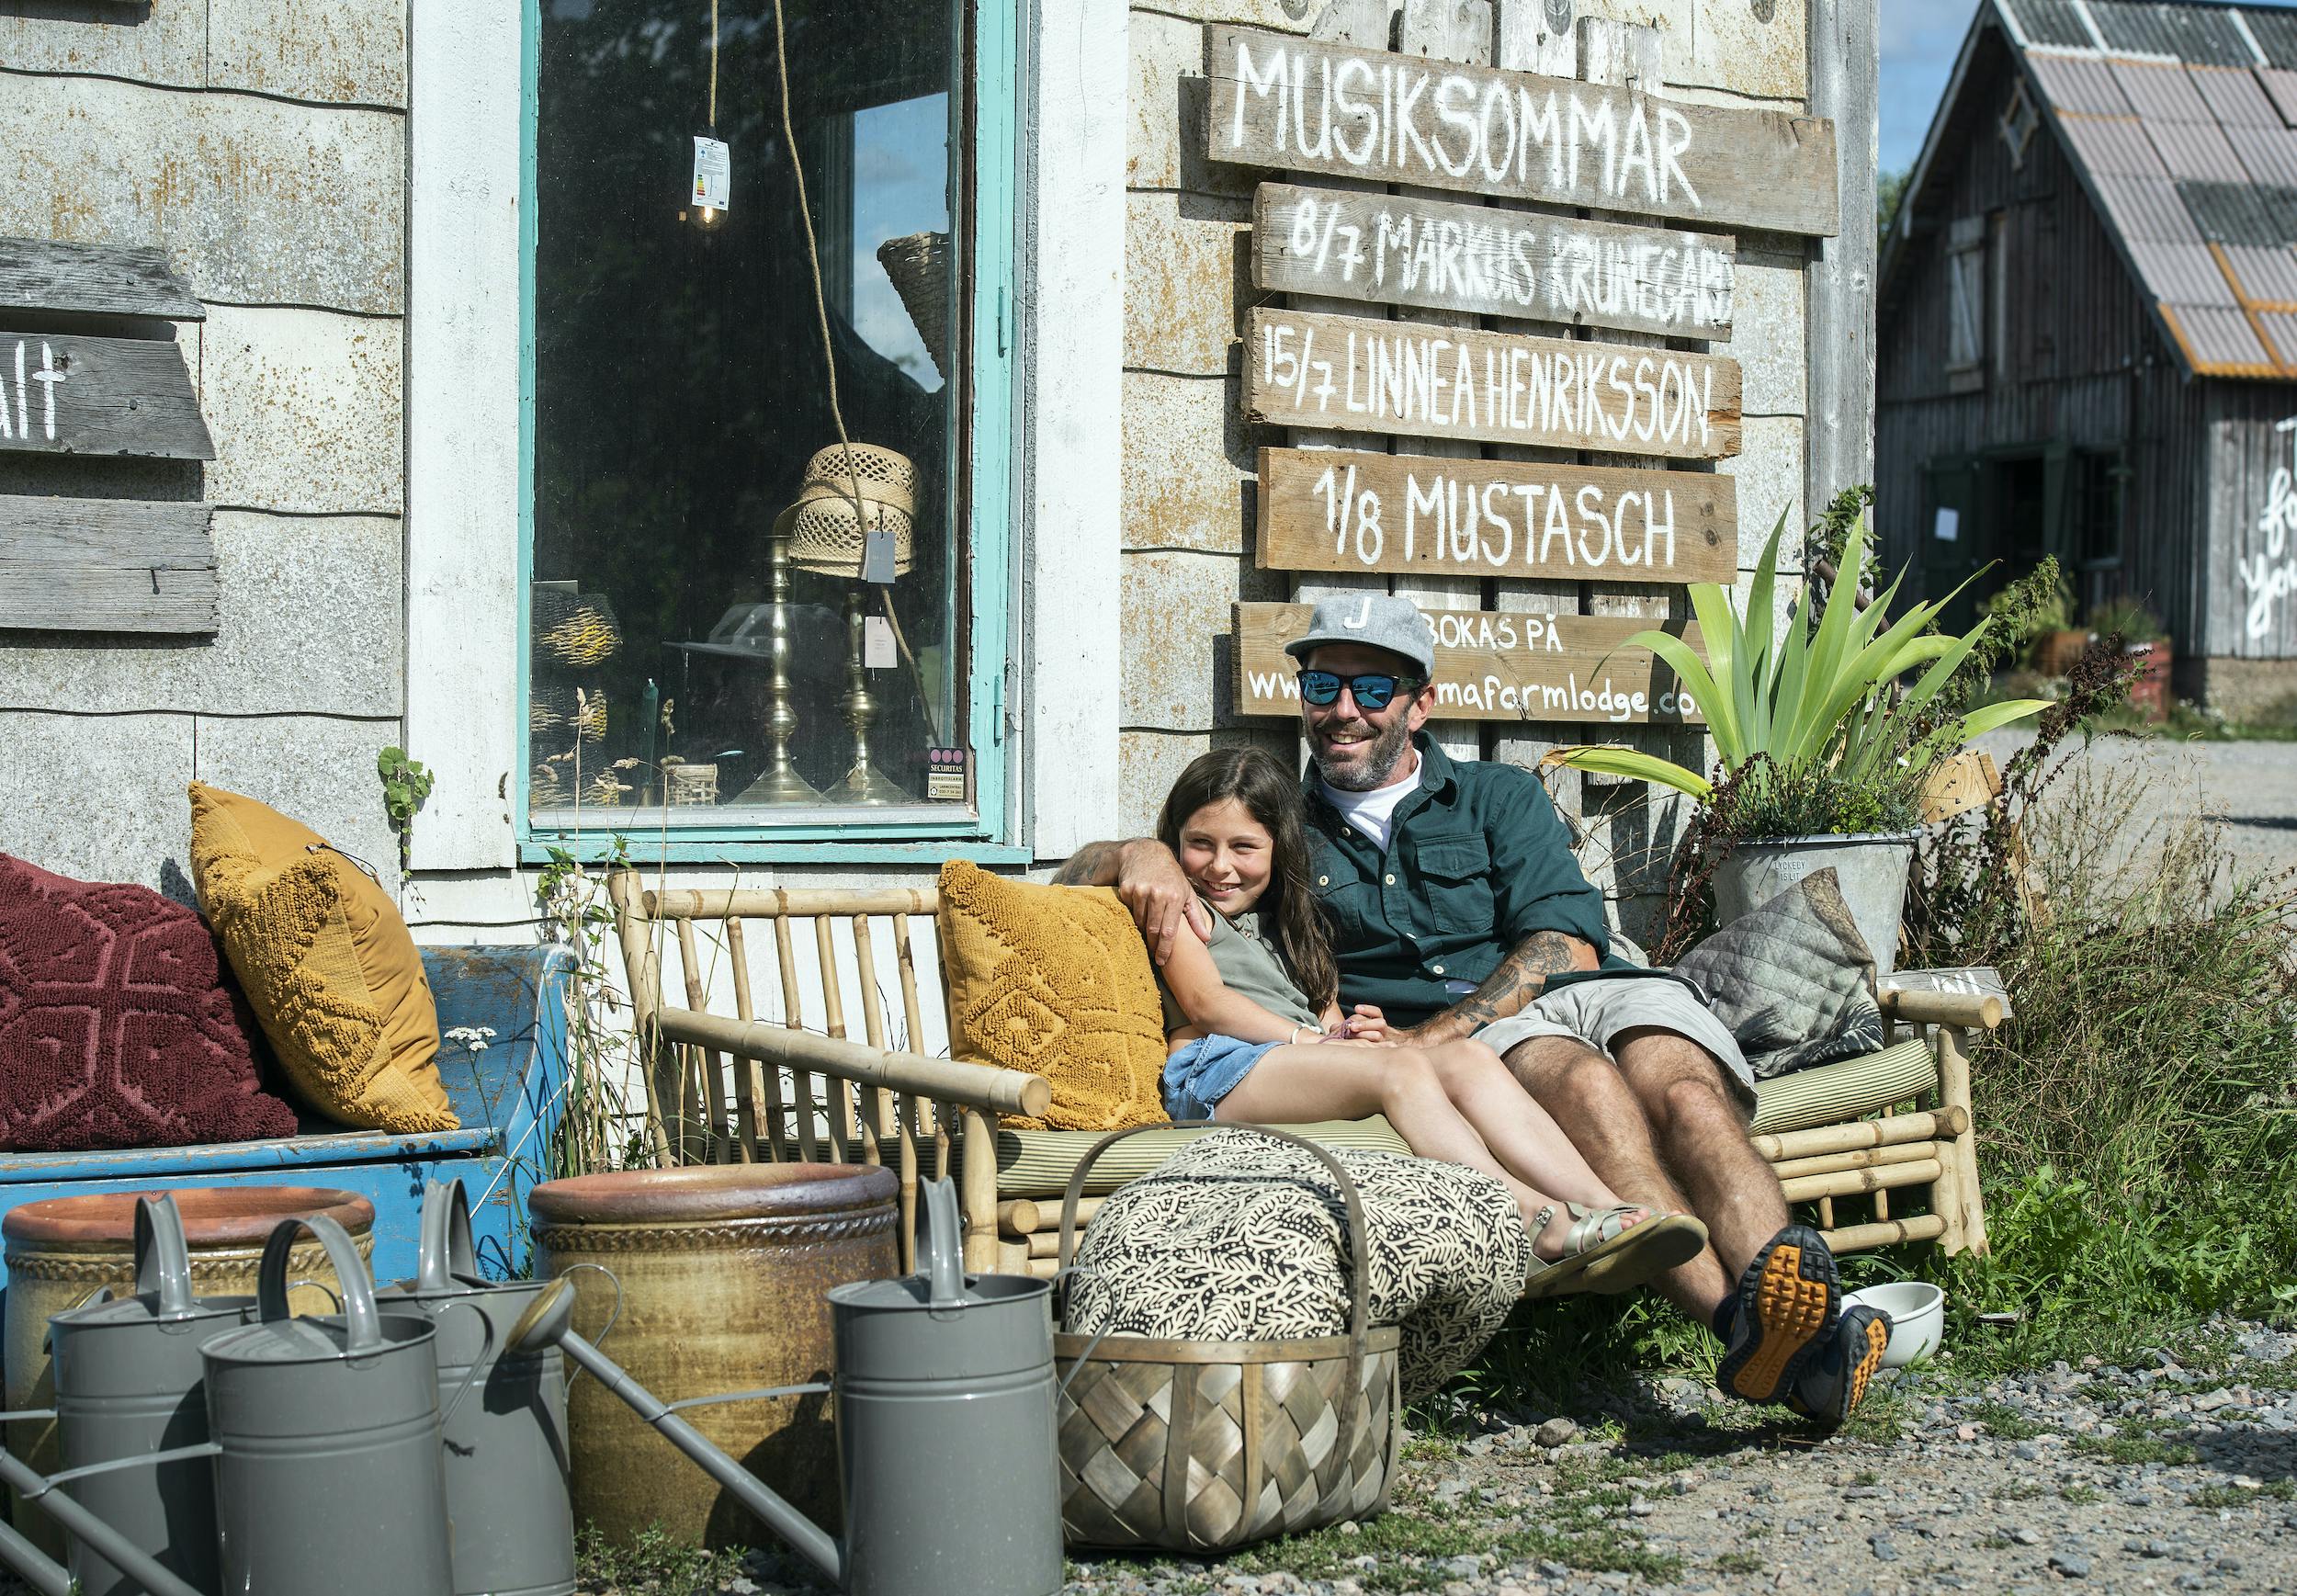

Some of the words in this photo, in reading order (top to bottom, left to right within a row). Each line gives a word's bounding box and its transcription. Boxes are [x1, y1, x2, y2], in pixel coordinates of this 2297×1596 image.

[1233, 42, 1703, 209] MUSIKSOMMAR
[1292, 198, 1365, 283] 8/7
[1376, 205, 1536, 307] MARKUS
[0, 340, 66, 440] lt
[1263, 324, 1337, 413] 15/7
[1346, 334, 1477, 428] LINNEA
[1487, 346, 1713, 447] HENRIKSSON
[1312, 464, 1385, 566] 1/8
[1405, 472, 1675, 567] MUSTASCH
[1342, 596, 1372, 629] J
[1526, 613, 1564, 651] PÅ
[930, 764, 963, 773] SECURITAS
[1774, 861, 1805, 870] LYCKEBY
